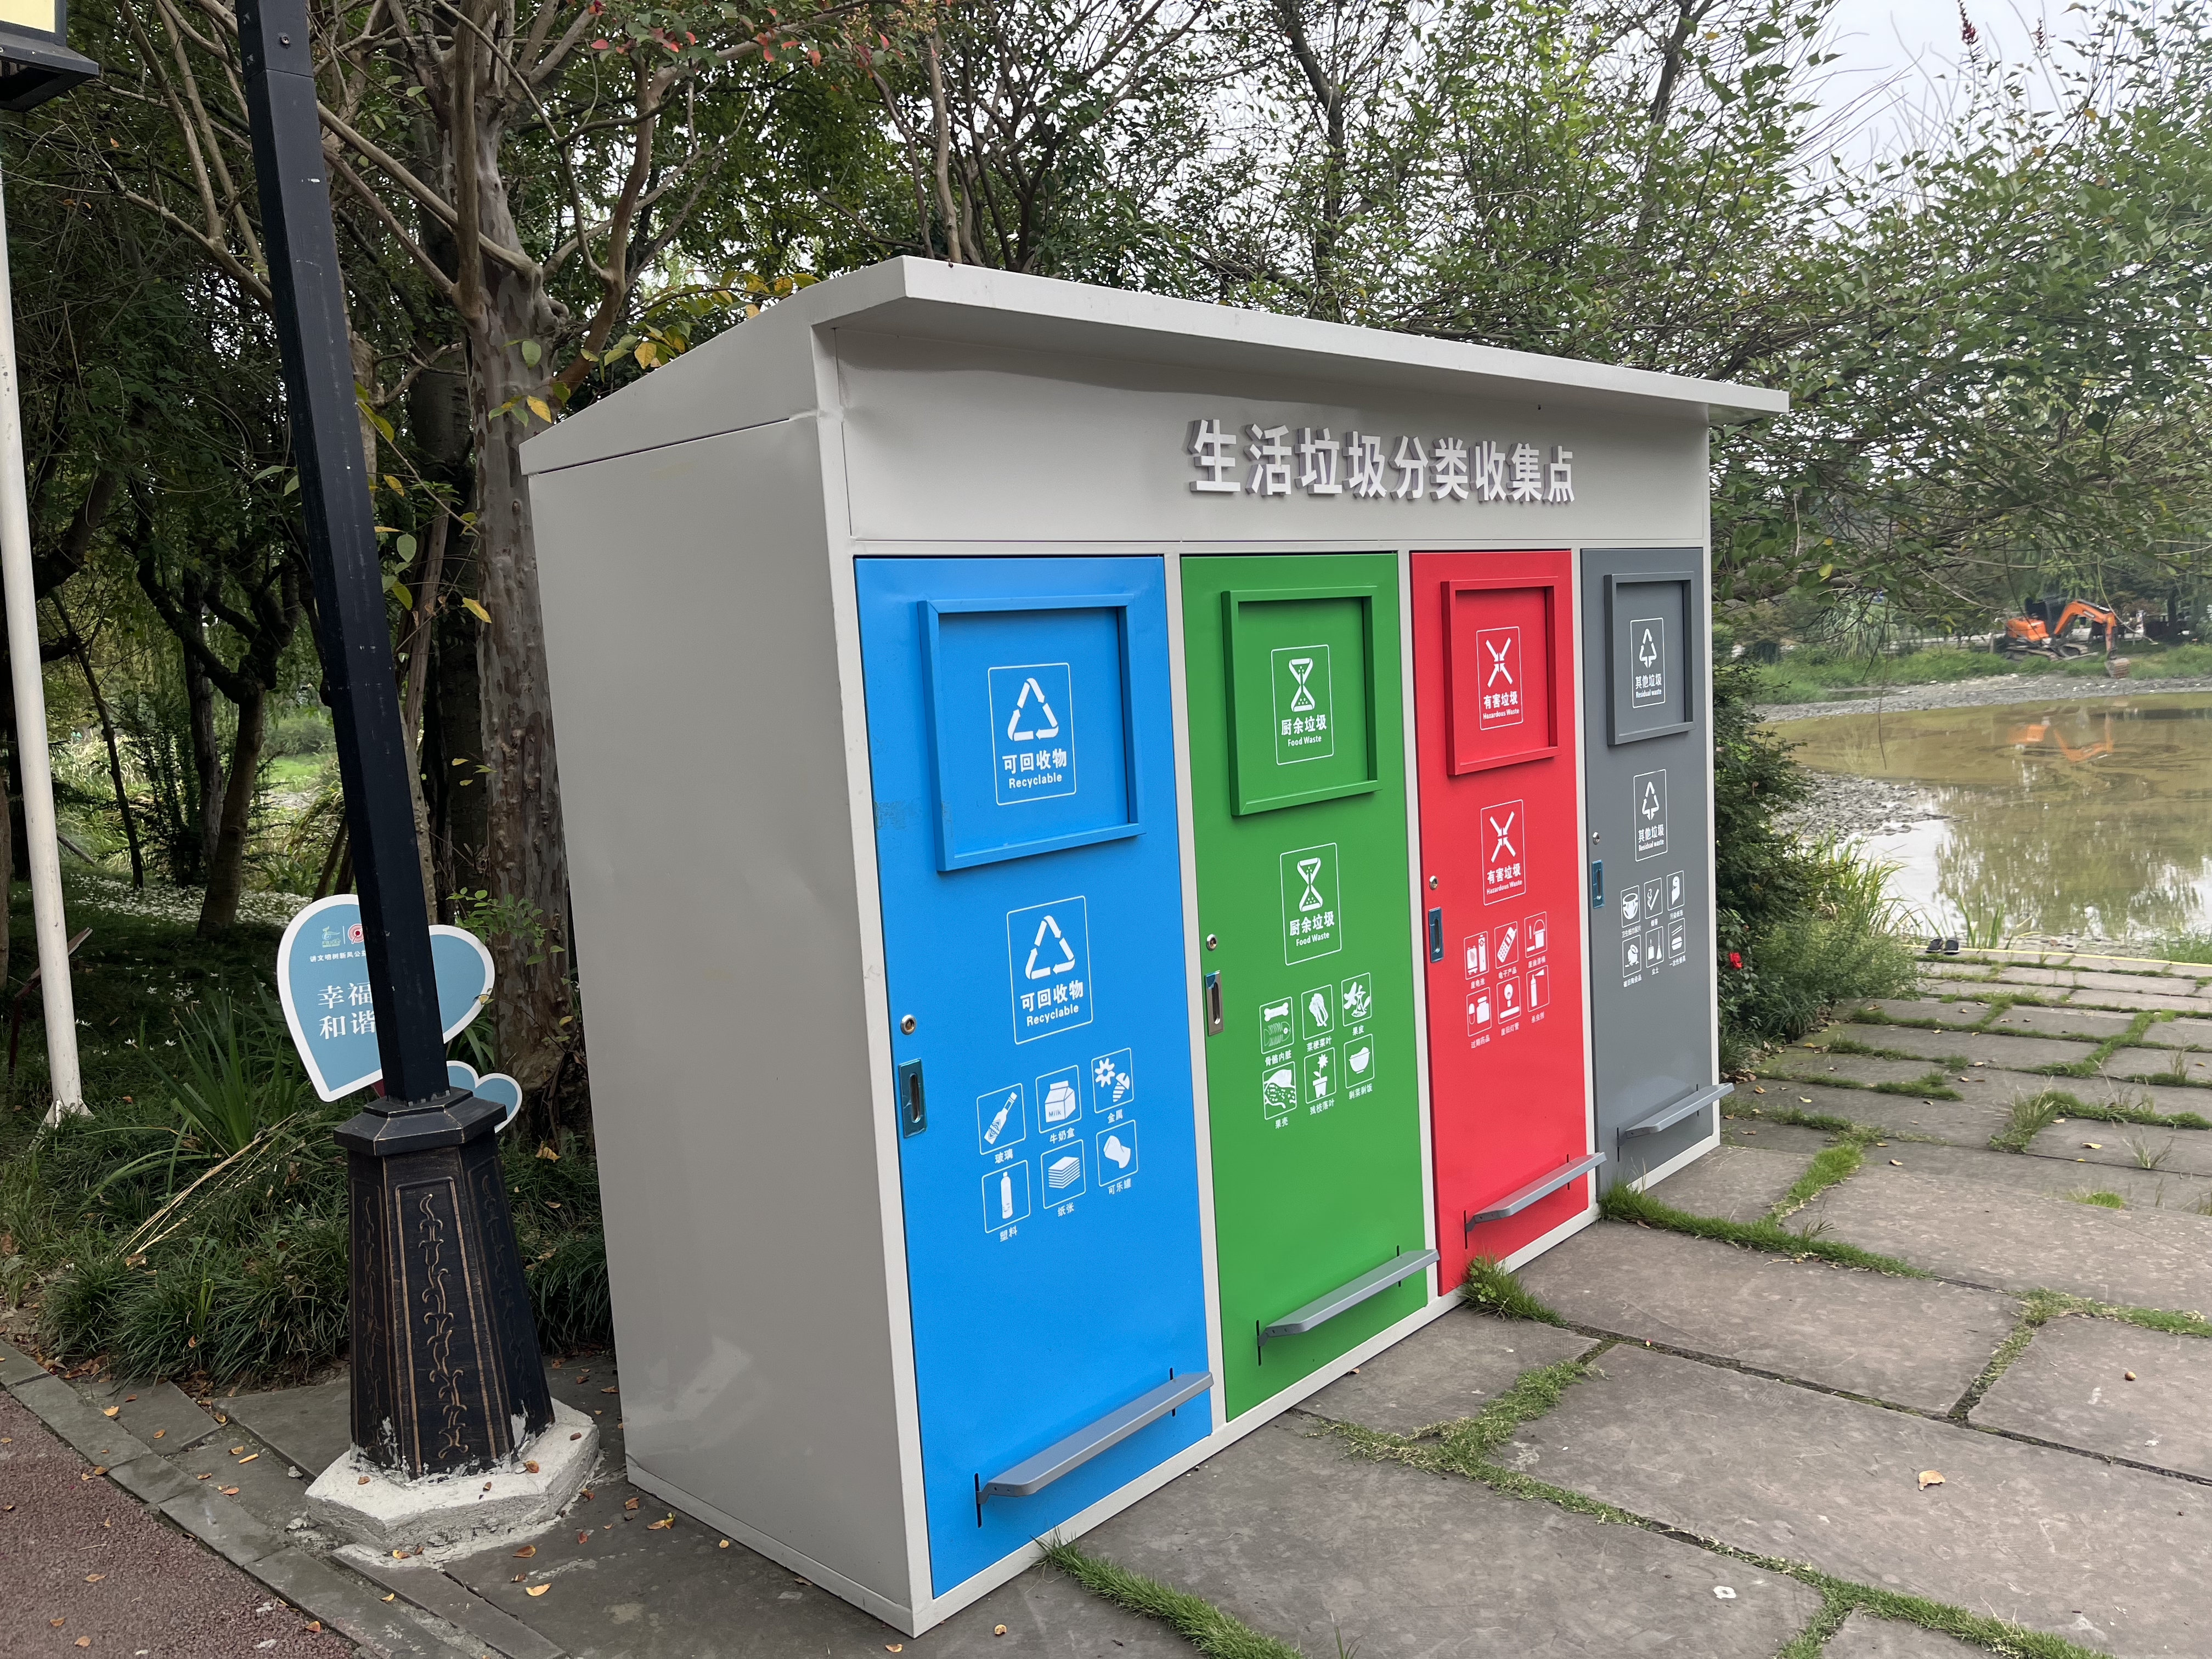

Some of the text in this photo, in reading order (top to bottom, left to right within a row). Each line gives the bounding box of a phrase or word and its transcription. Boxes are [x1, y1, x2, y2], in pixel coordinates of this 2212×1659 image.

[1187, 419, 1575, 503] 生活垃圾分类收集点
[1635, 673, 1662, 690] 其他垃圾
[1483, 691, 1518, 709] 有害垃圾
[1483, 710, 1506, 720] Hazardous
[1281, 714, 1327, 735] 厨余垃圾
[1288, 735, 1322, 747] Food Waste
[1002, 748, 1067, 774] 可回收物
[1009, 772, 1062, 788] Recyclable
[1638, 824, 1664, 843] 其他垃圾
[1638, 840, 1654, 851] Residual
[1487, 862, 1521, 884] 有害垃圾
[1486, 879, 1522, 895] Hazardous Waste
[1289, 911, 1335, 936] 厨余垃圾
[1296, 932, 1330, 946] Food Waste
[1498, 967, 1517, 979] 电子产品
[1470, 977, 1485, 990] 废电池
[318, 982, 373, 1008] 幸福
[1020, 980, 1084, 1012] 可回收物
[1027, 1004, 1079, 1026] Recyclable
[319, 1010, 375, 1039] 和谐
[1352, 1025, 1364, 1036] 果皮
[1470, 1034, 1490, 1049] 过期药品
[1265, 1049, 1292, 1066] 骨骼内脏
[1348, 1083, 1373, 1099] 剩菜剩饭
[1048, 1110, 1061, 1118] Milk
[1310, 1098, 1335, 1115] 残枝落叶
[1108, 1109, 1123, 1124] 金属
[1275, 1116, 1288, 1129] 果壳
[1049, 1127, 1075, 1144] 牛奶盒
[994, 1149, 1013, 1164] 玻璃
[1108, 1178, 1132, 1195] 可乐罐
[1057, 1203, 1074, 1217] 纸张
[1000, 1226, 1017, 1242] 塑料
